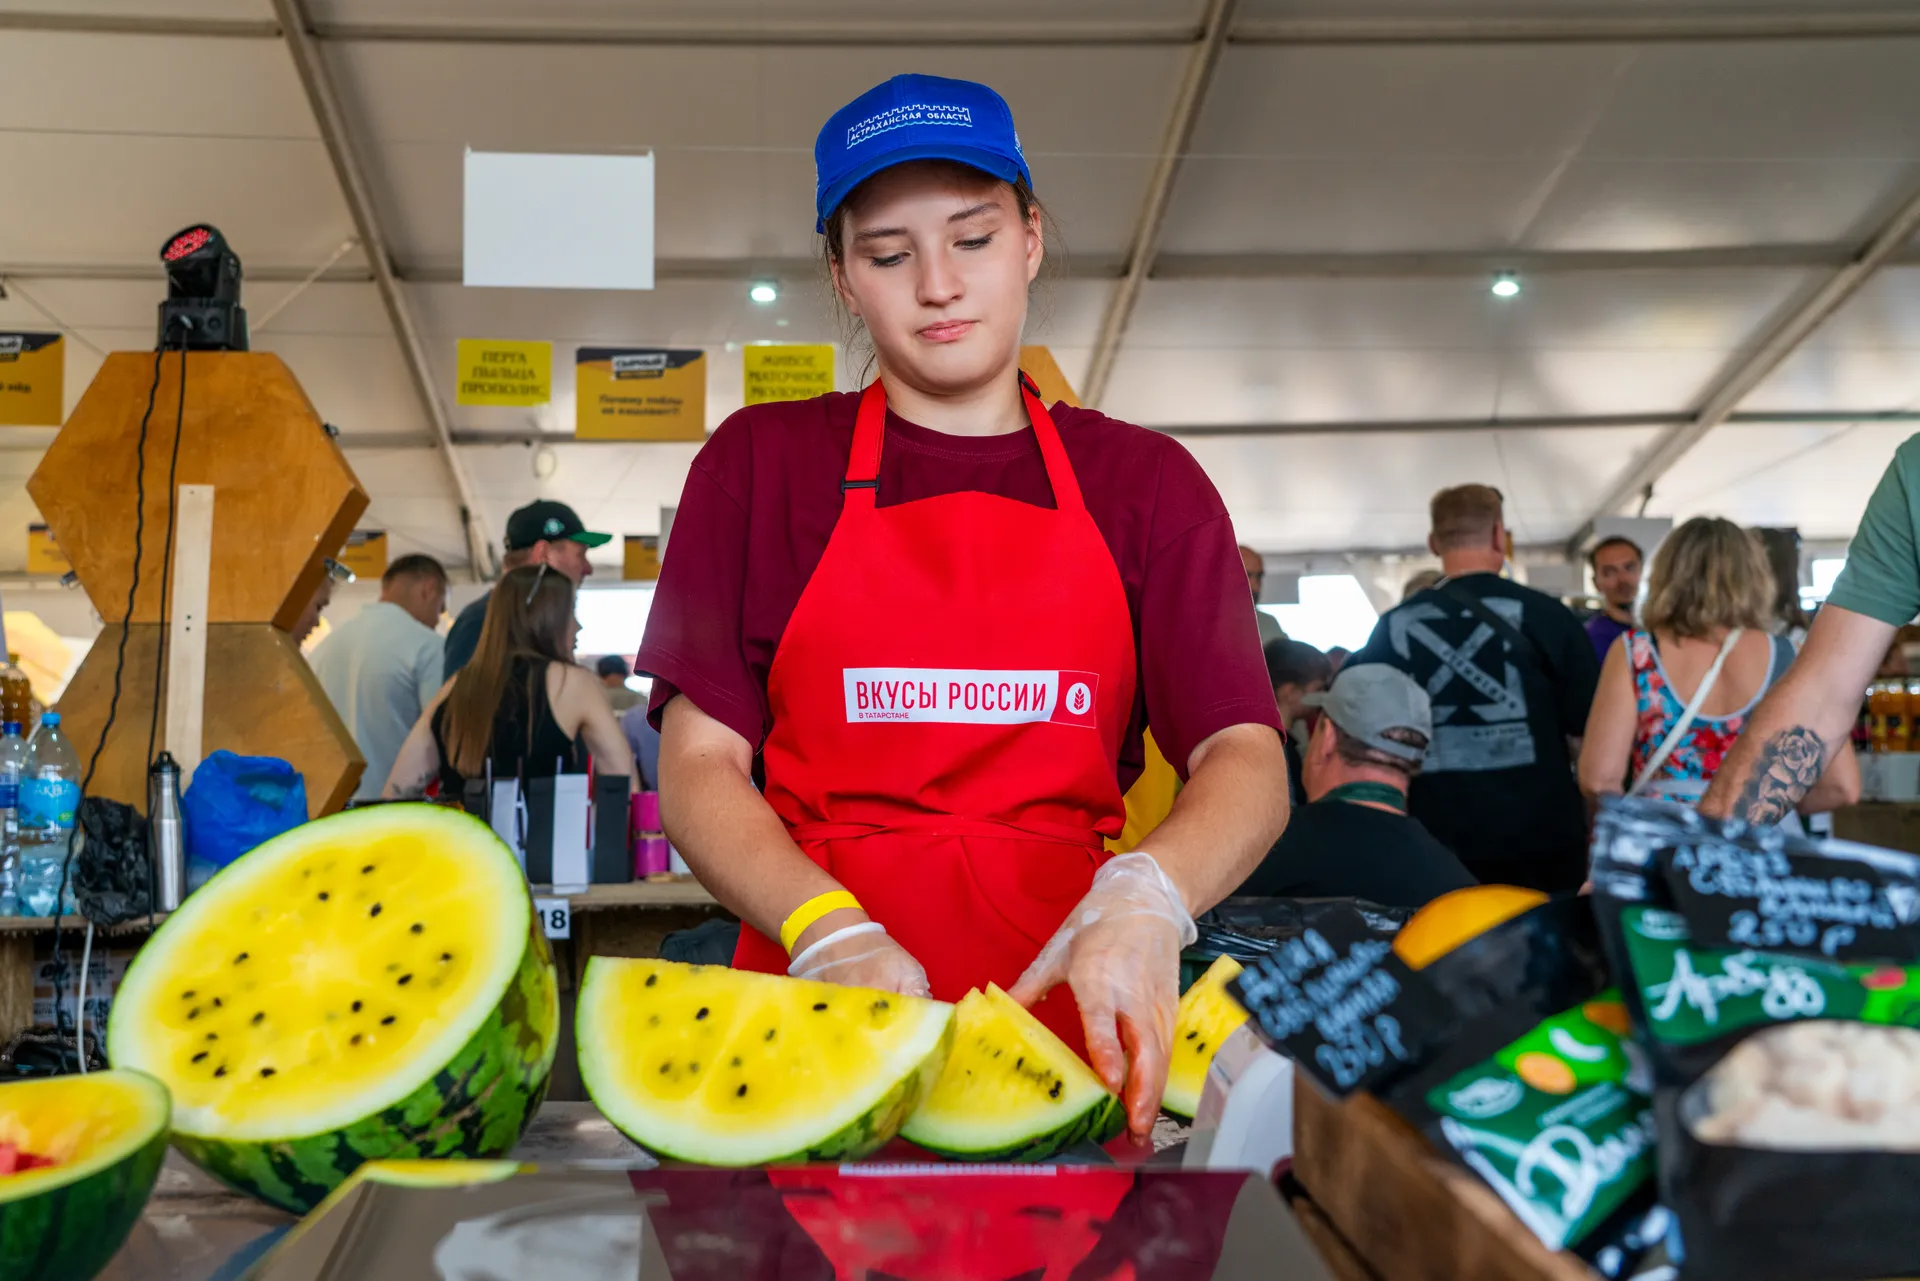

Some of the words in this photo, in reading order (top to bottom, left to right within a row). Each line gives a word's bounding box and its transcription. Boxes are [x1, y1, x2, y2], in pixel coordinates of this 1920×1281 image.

[850, 111, 922, 142] АСТРАХАНСКАЯ
[926, 111, 970, 122] ОБЛАСТЬ
[856, 680, 938, 710] ВКУСЫ
[947, 681, 1047, 712] РОССИИ
[865, 711, 910, 719] ТАТАРСТАНЕ
